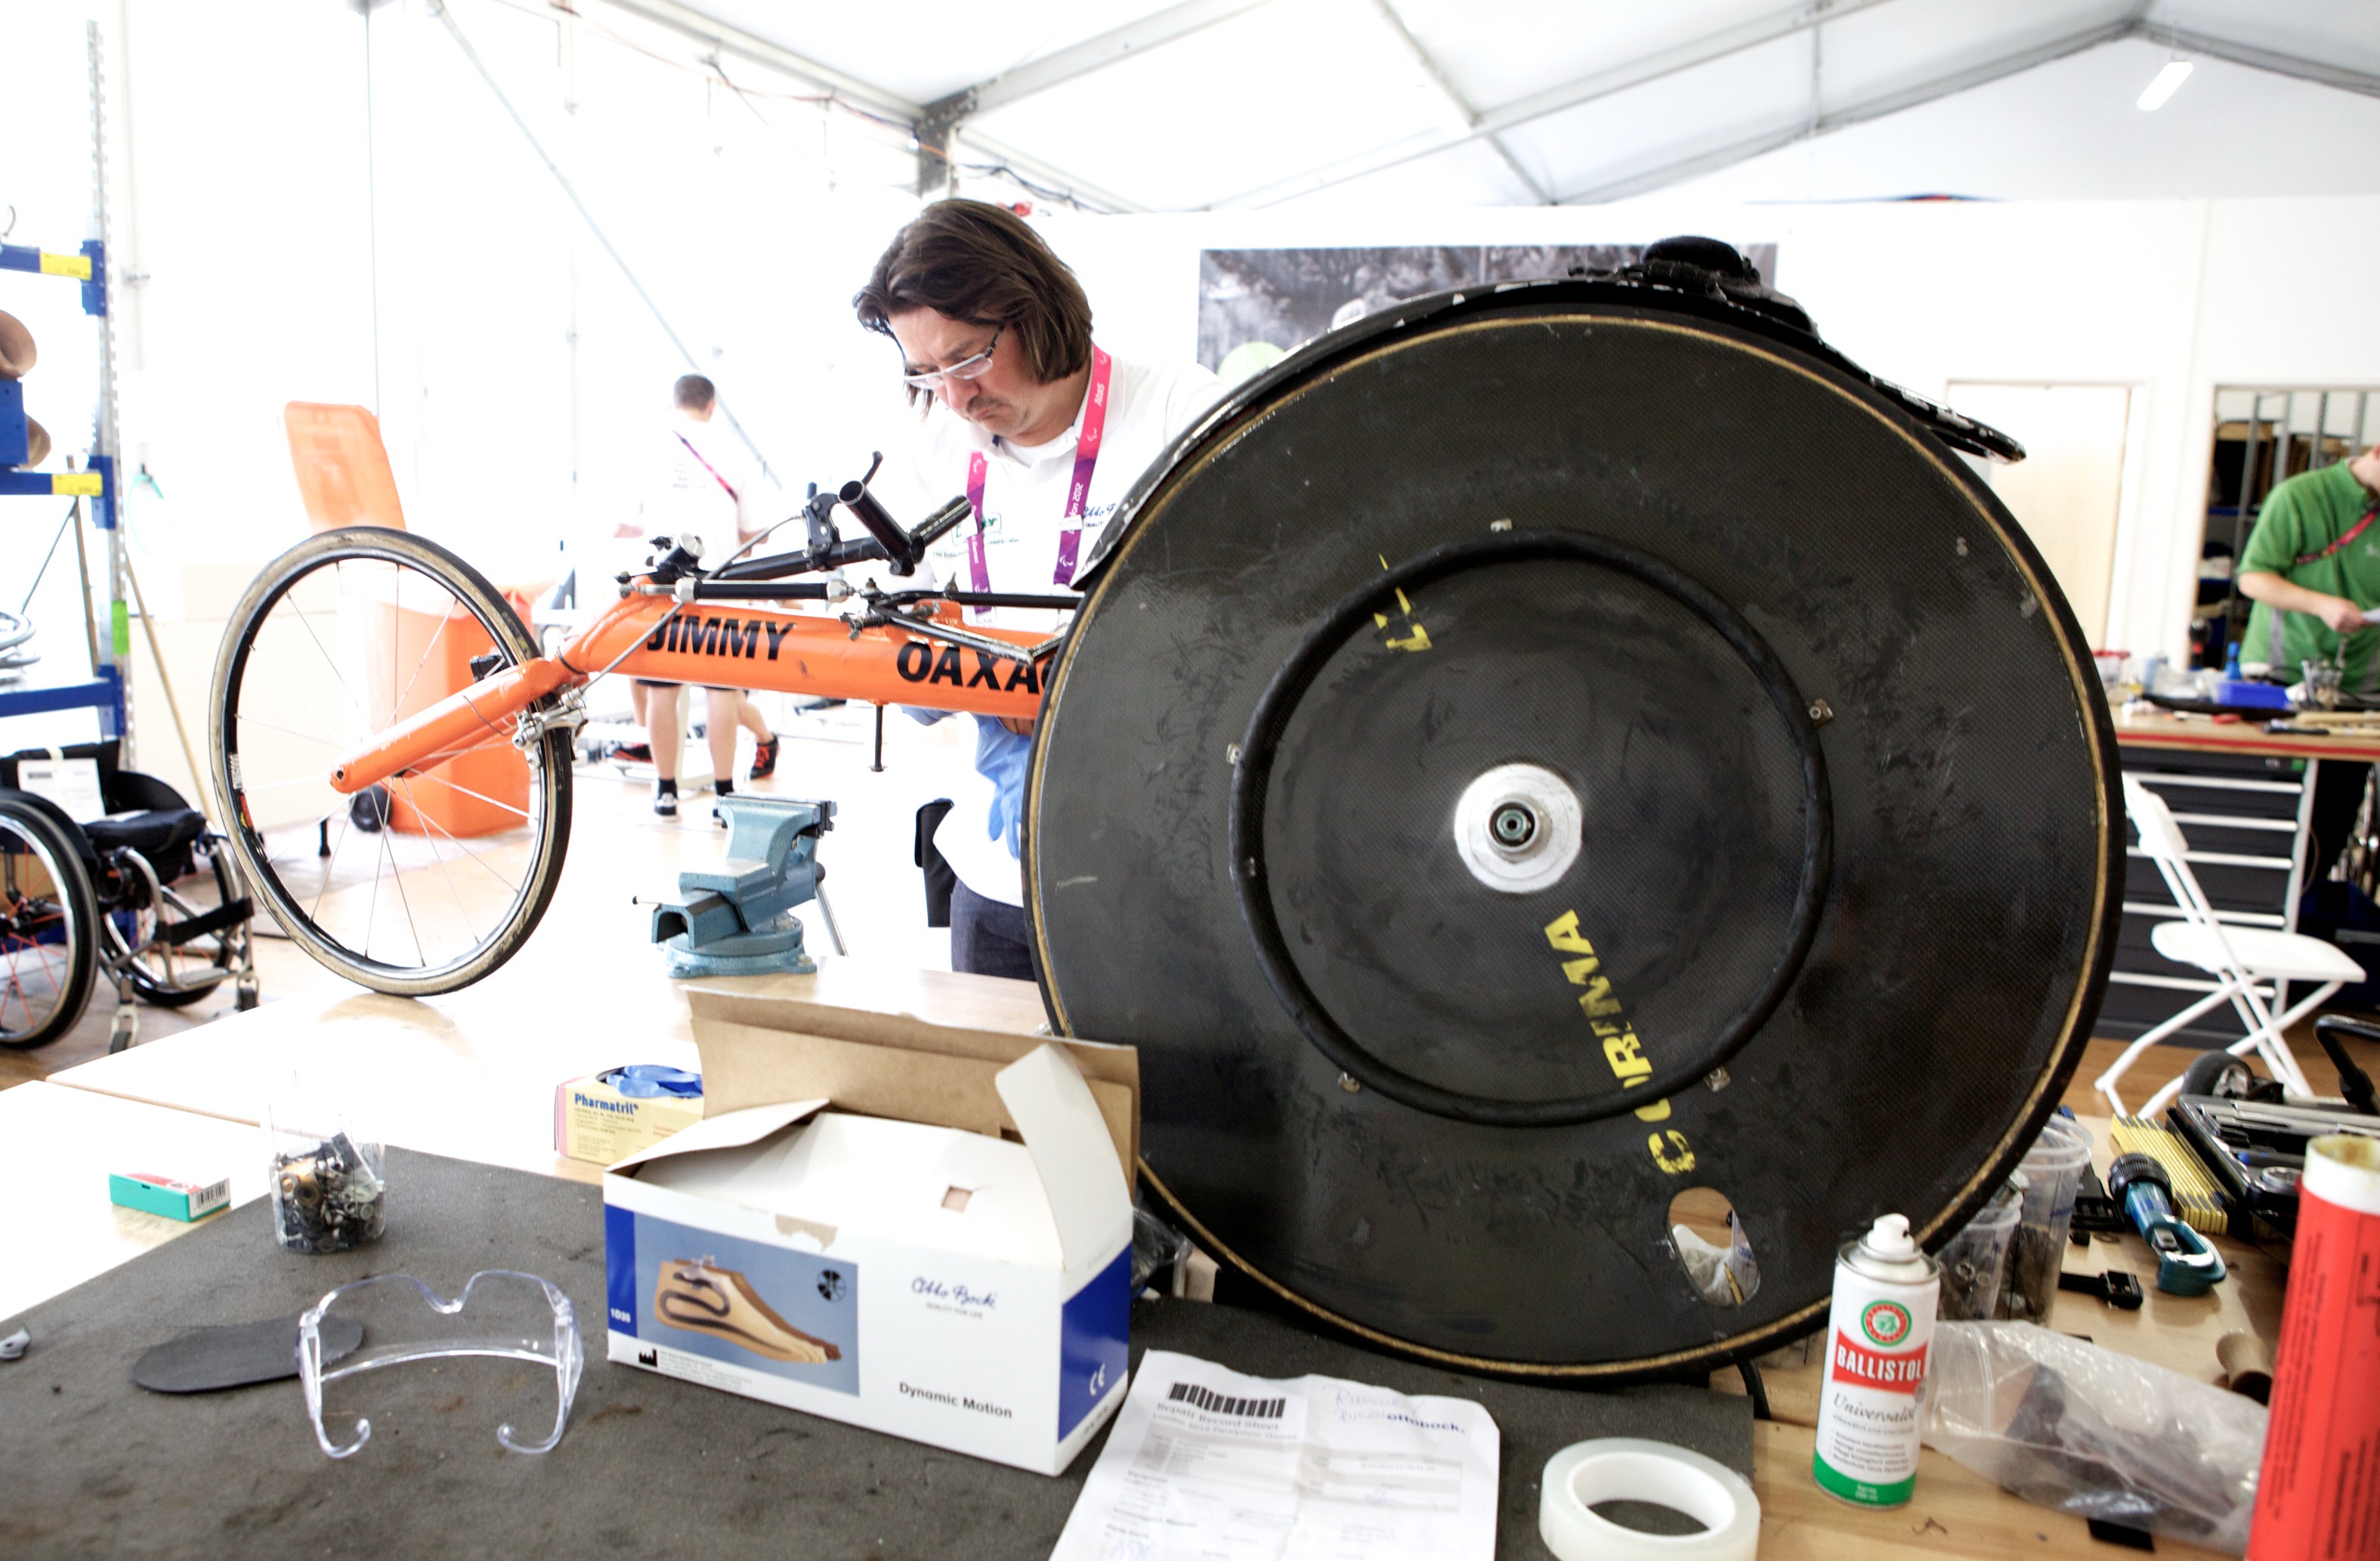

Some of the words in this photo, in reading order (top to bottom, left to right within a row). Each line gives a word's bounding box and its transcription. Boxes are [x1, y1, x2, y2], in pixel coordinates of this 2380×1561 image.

[647, 613, 796, 660] JIMMY
[897, 642, 1054, 694] OAXA
[1837, 1344, 1922, 1382] BALLISTOL
[899, 1381, 958, 1406] Dynamic
[963, 1397, 1012, 1419] Motion
[1157, 1402, 1195, 1419] Repair
[1199, 1413, 1241, 1427] Record
[1246, 1420, 1279, 1431] Sheet
